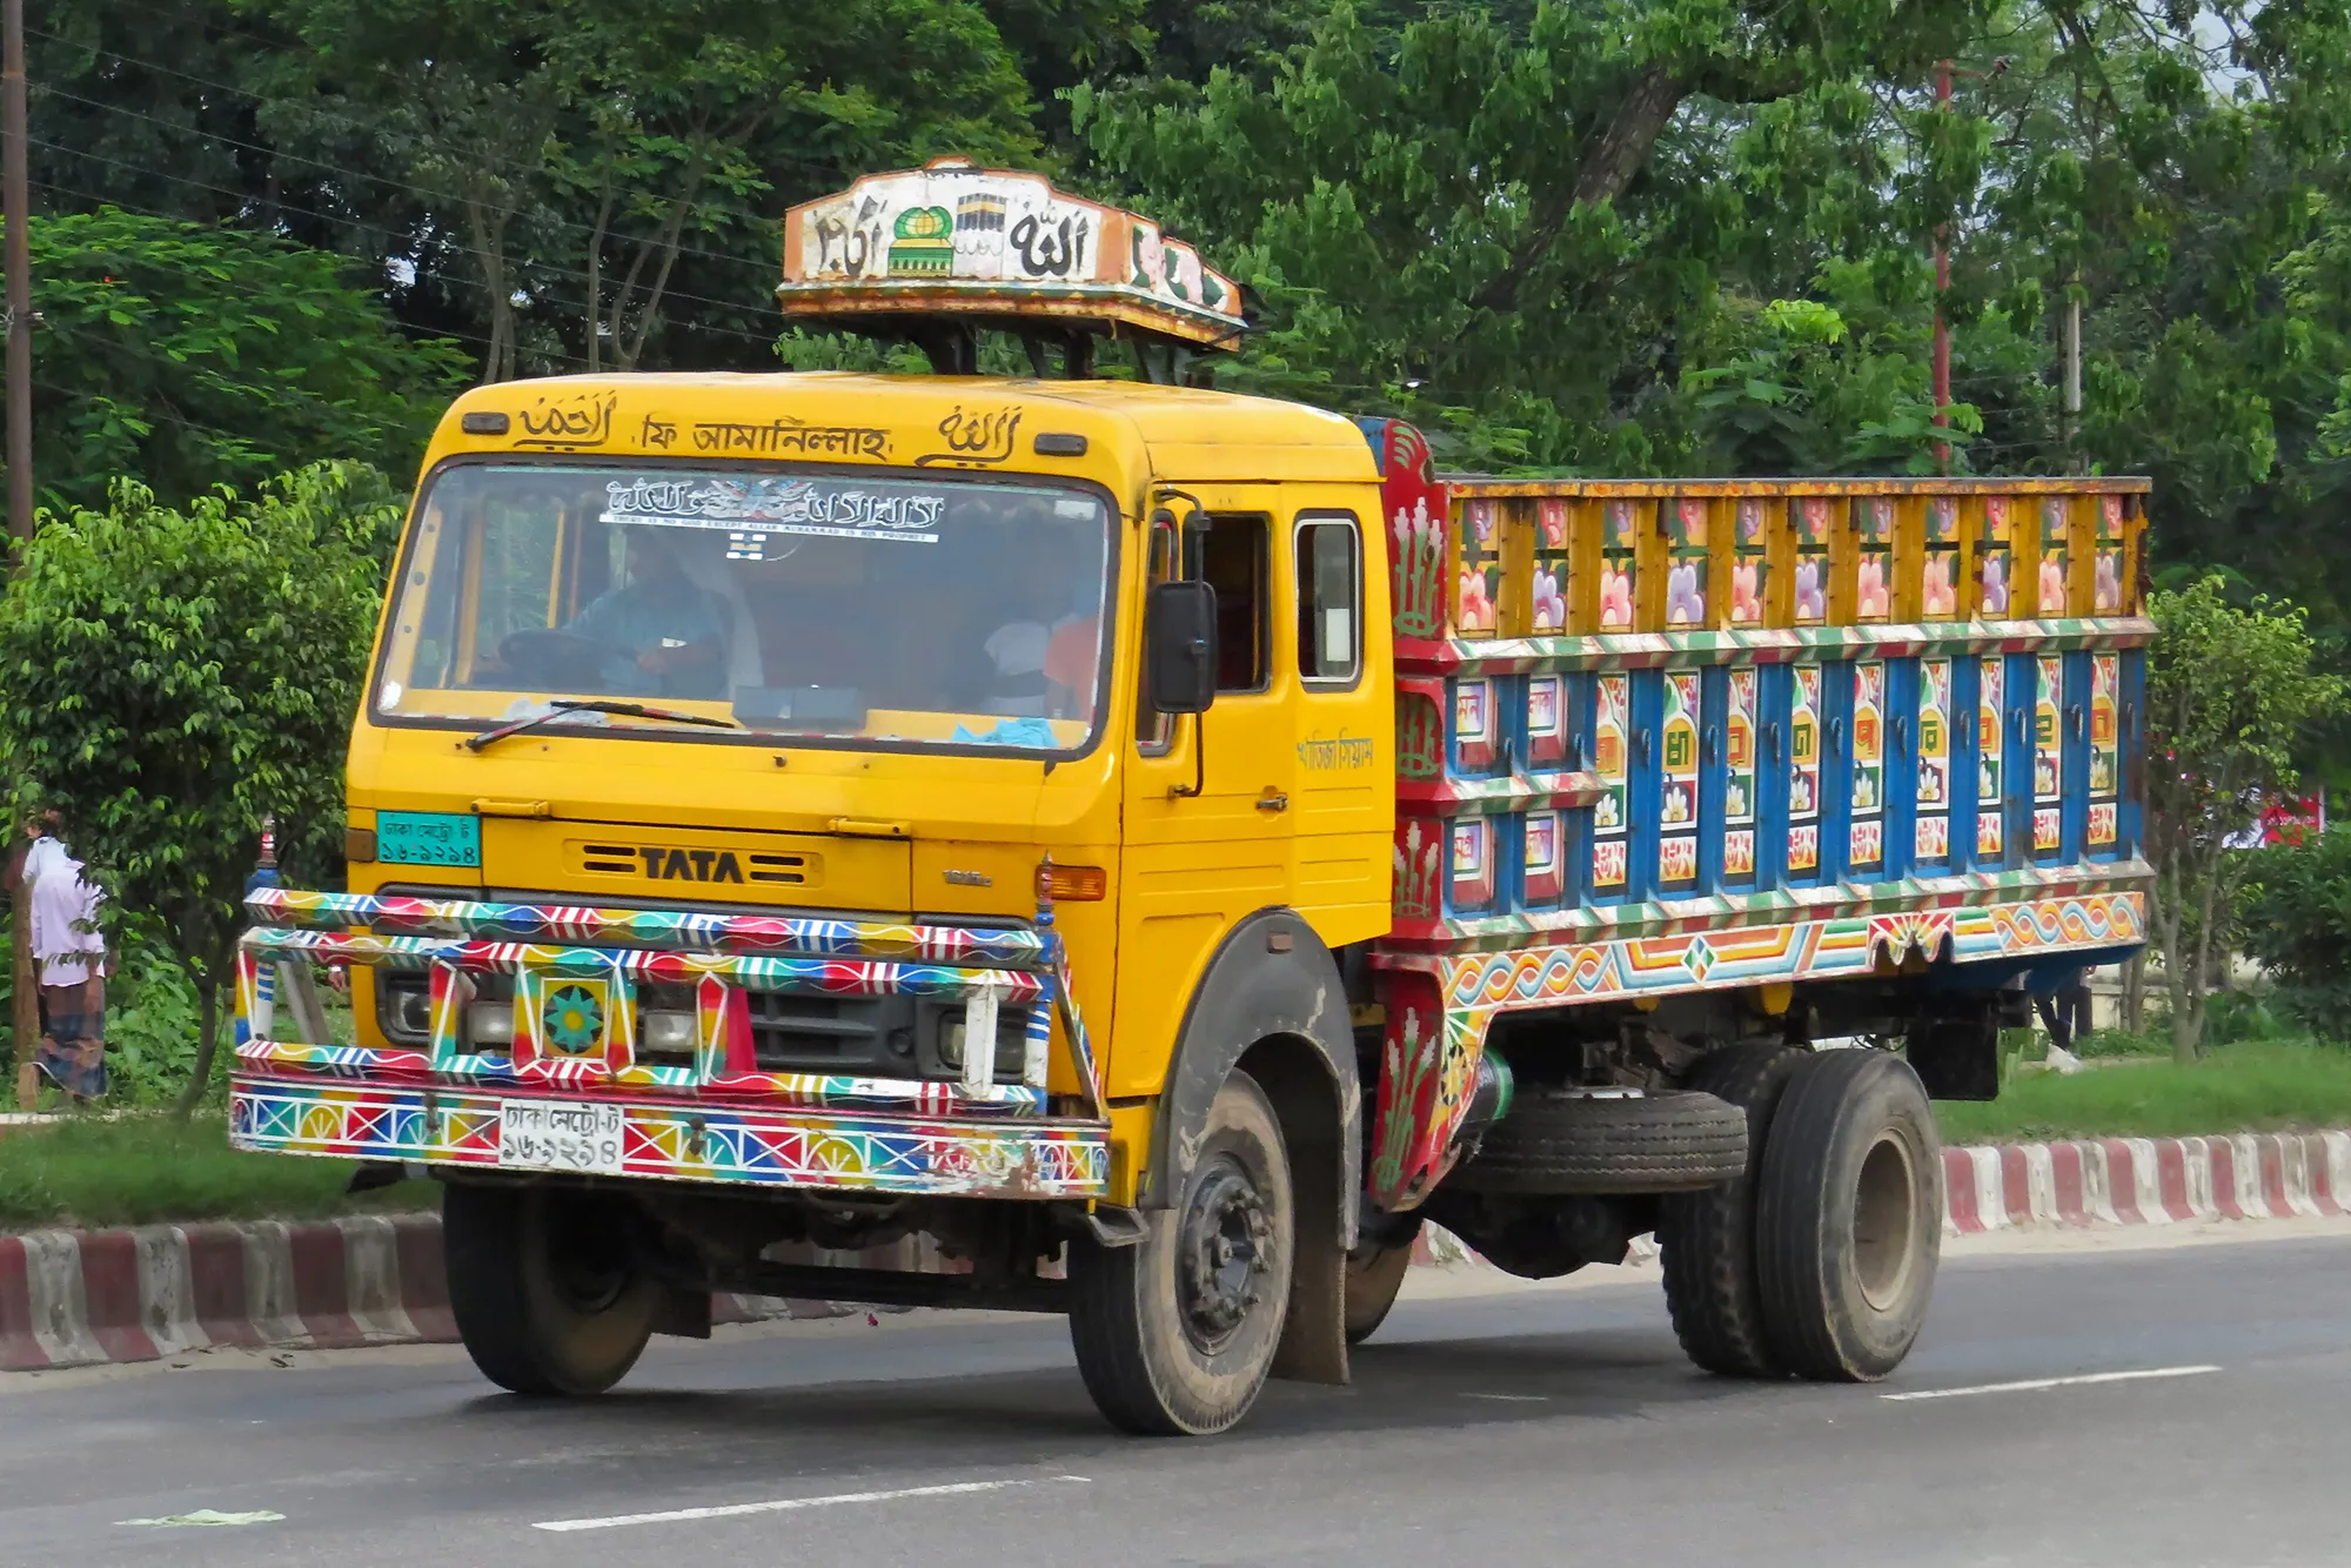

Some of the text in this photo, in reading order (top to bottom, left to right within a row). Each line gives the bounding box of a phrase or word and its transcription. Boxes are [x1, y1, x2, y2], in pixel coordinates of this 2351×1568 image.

[642, 411, 678, 450] ফি
[386, 823, 413, 835] ঢাকা
[639, 847, 745, 884] TATA
